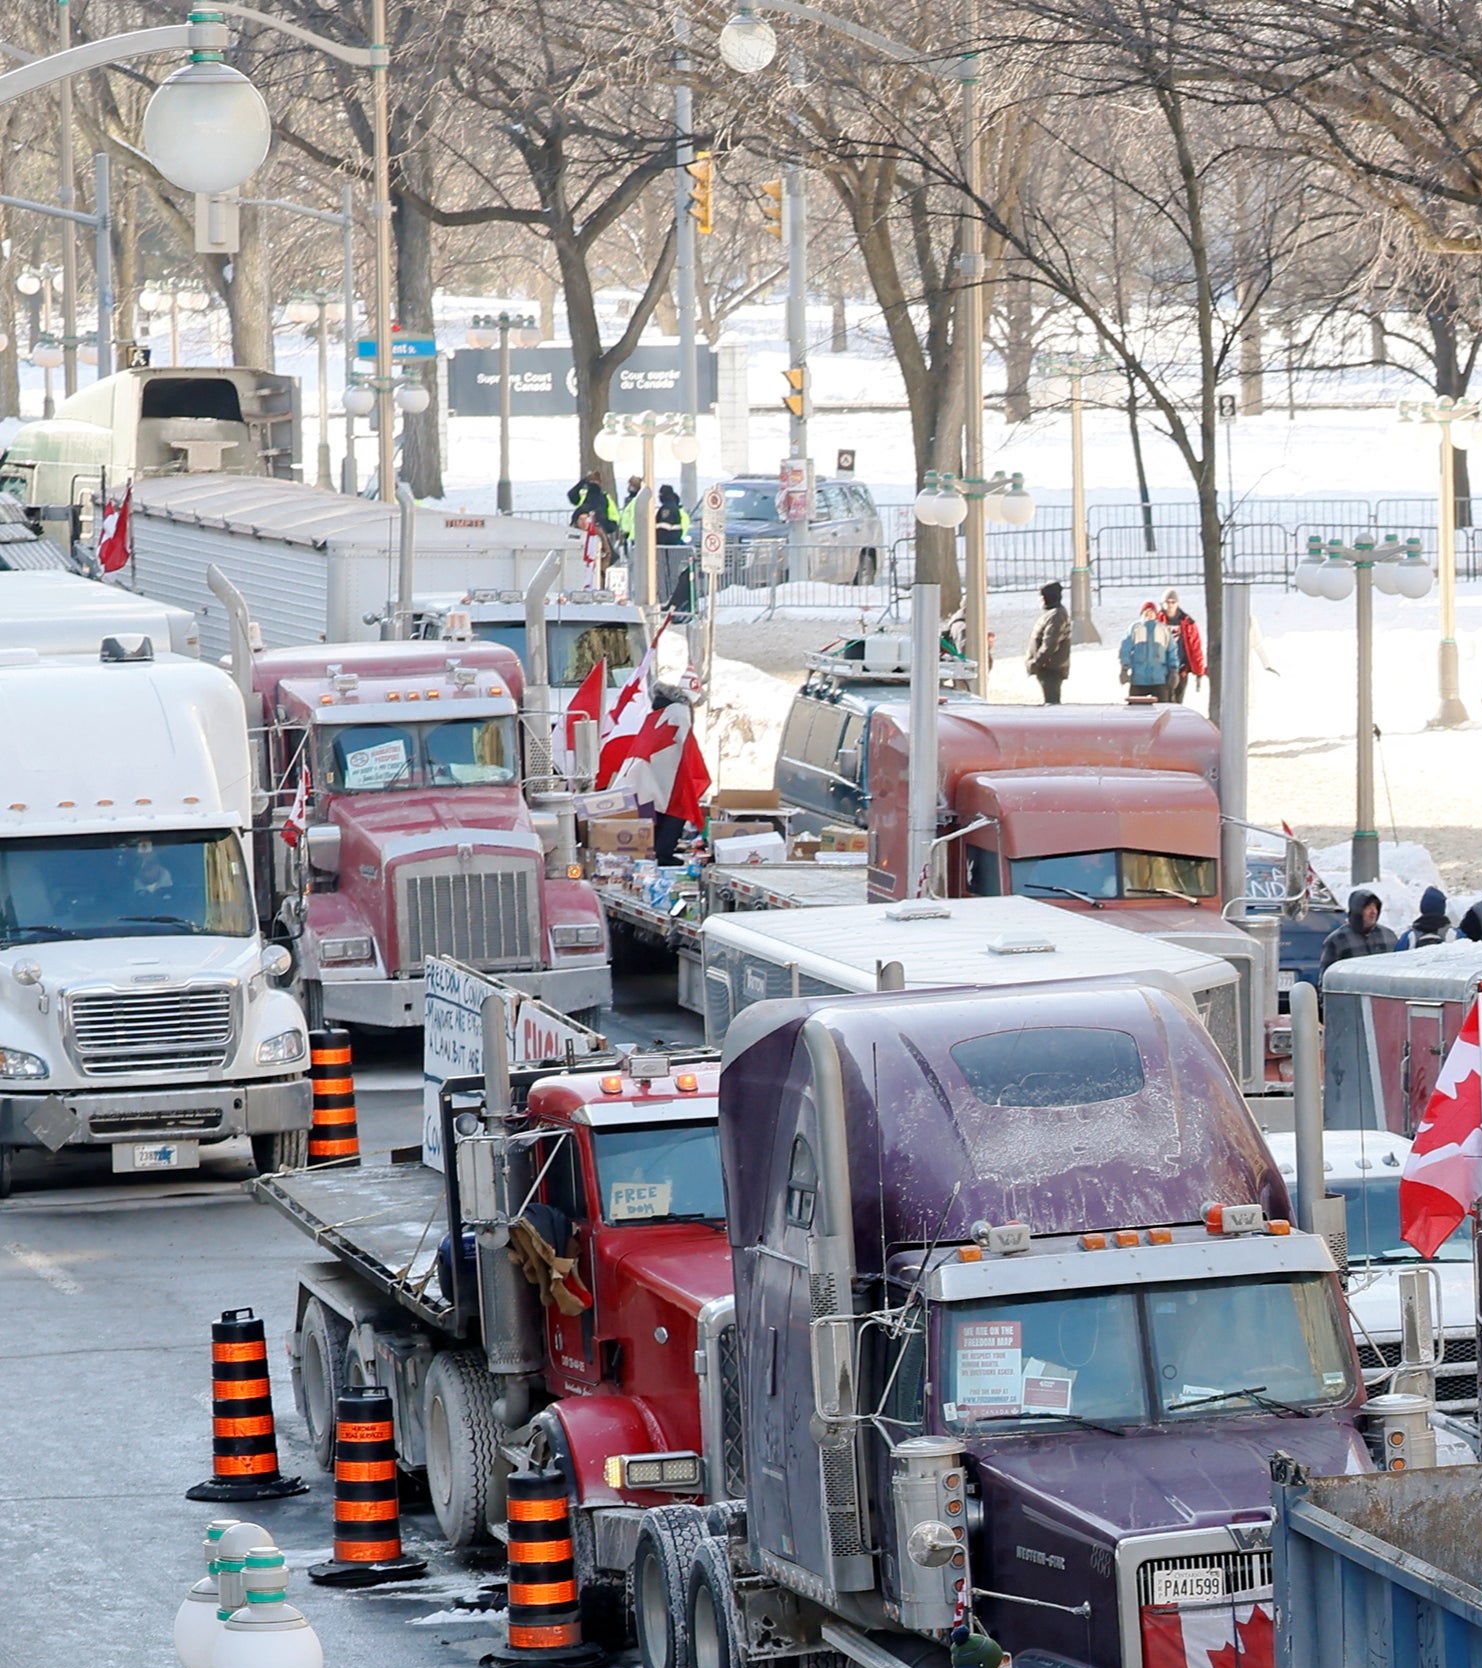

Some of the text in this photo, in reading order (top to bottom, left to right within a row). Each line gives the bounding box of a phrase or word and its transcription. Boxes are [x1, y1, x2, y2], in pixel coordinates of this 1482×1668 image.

[524, 372, 552, 383] Court
[621, 370, 646, 382] Cour
[620, 379, 674, 389] du Canada
[614, 1186, 658, 1205] FREE
[626, 1203, 656, 1214] DOM
[963, 1326, 1014, 1336] WE ARE ON THE
[963, 1337, 1013, 1347] FREEDOM MAP
[1164, 1578, 1220, 1598] PA41599
